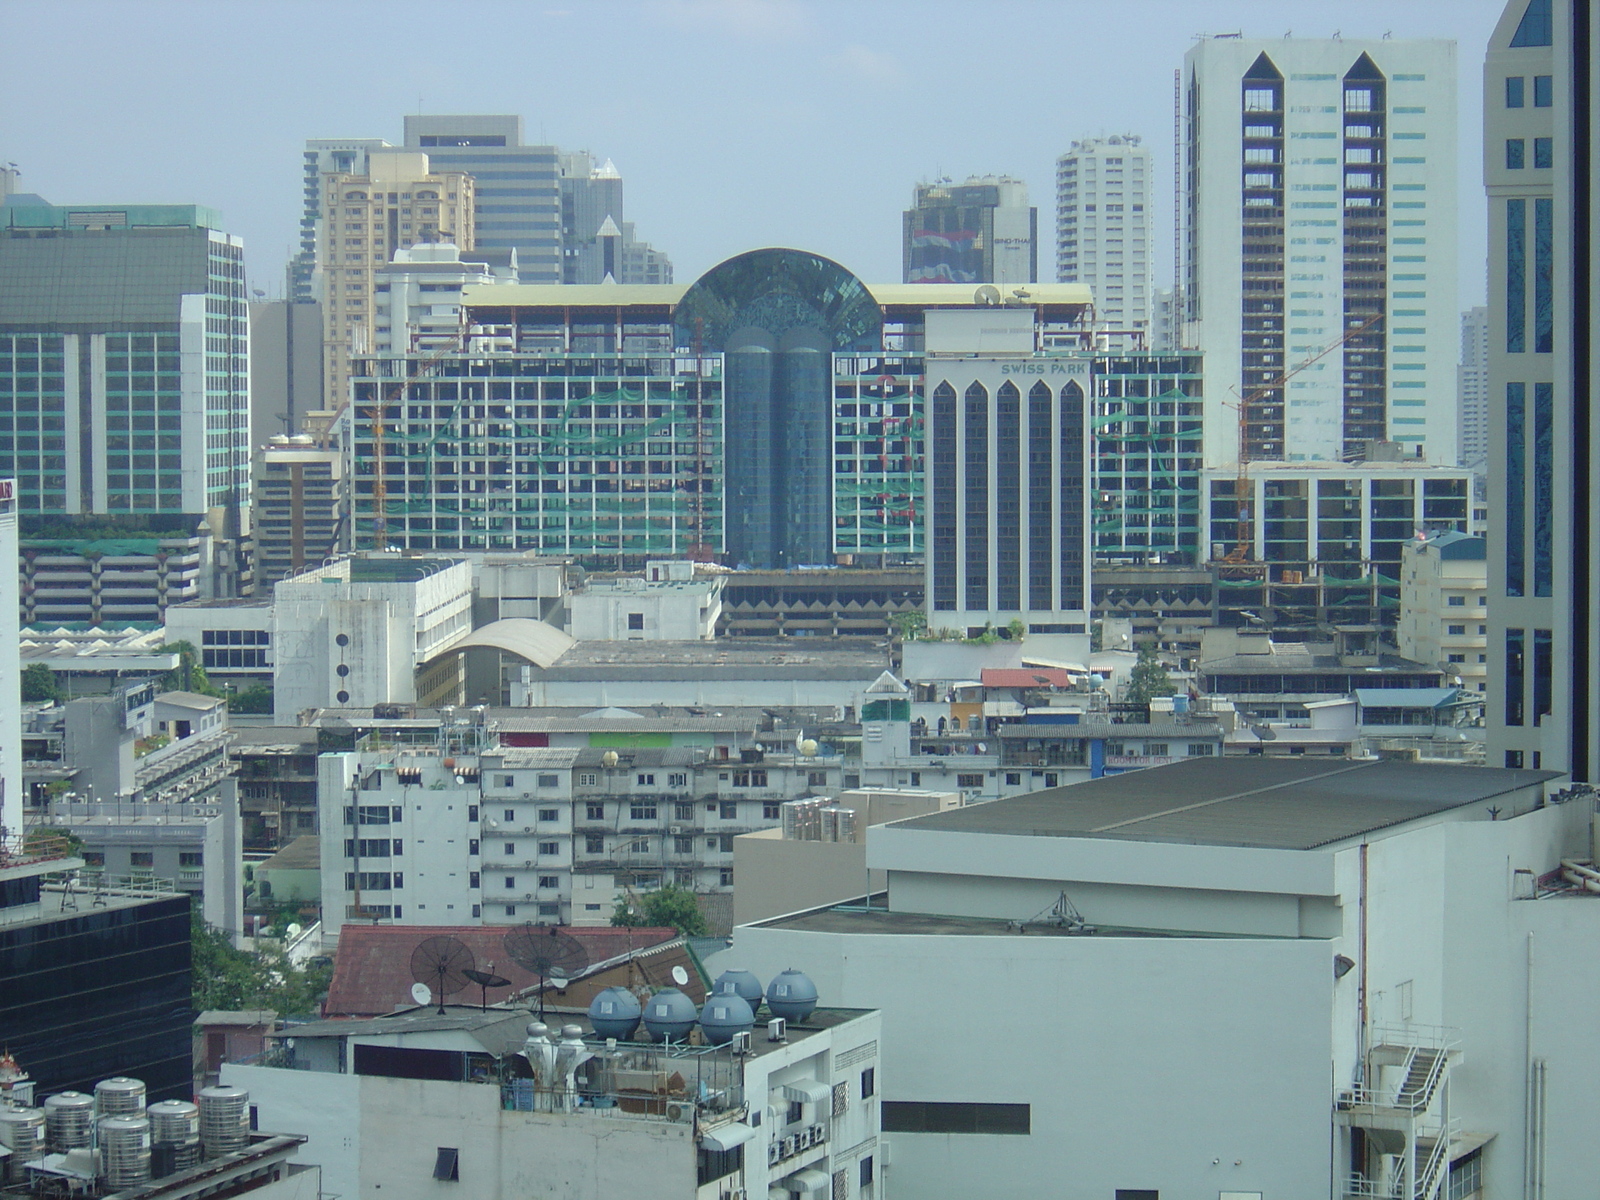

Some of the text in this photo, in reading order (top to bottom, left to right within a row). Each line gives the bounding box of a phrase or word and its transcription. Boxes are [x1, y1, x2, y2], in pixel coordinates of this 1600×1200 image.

[1001, 364, 1085, 374] SWISS PARK
[1108, 756, 1132, 765] ROOM
[1134, 756, 1151, 765] FOR
[1154, 756, 1172, 764] RENT
